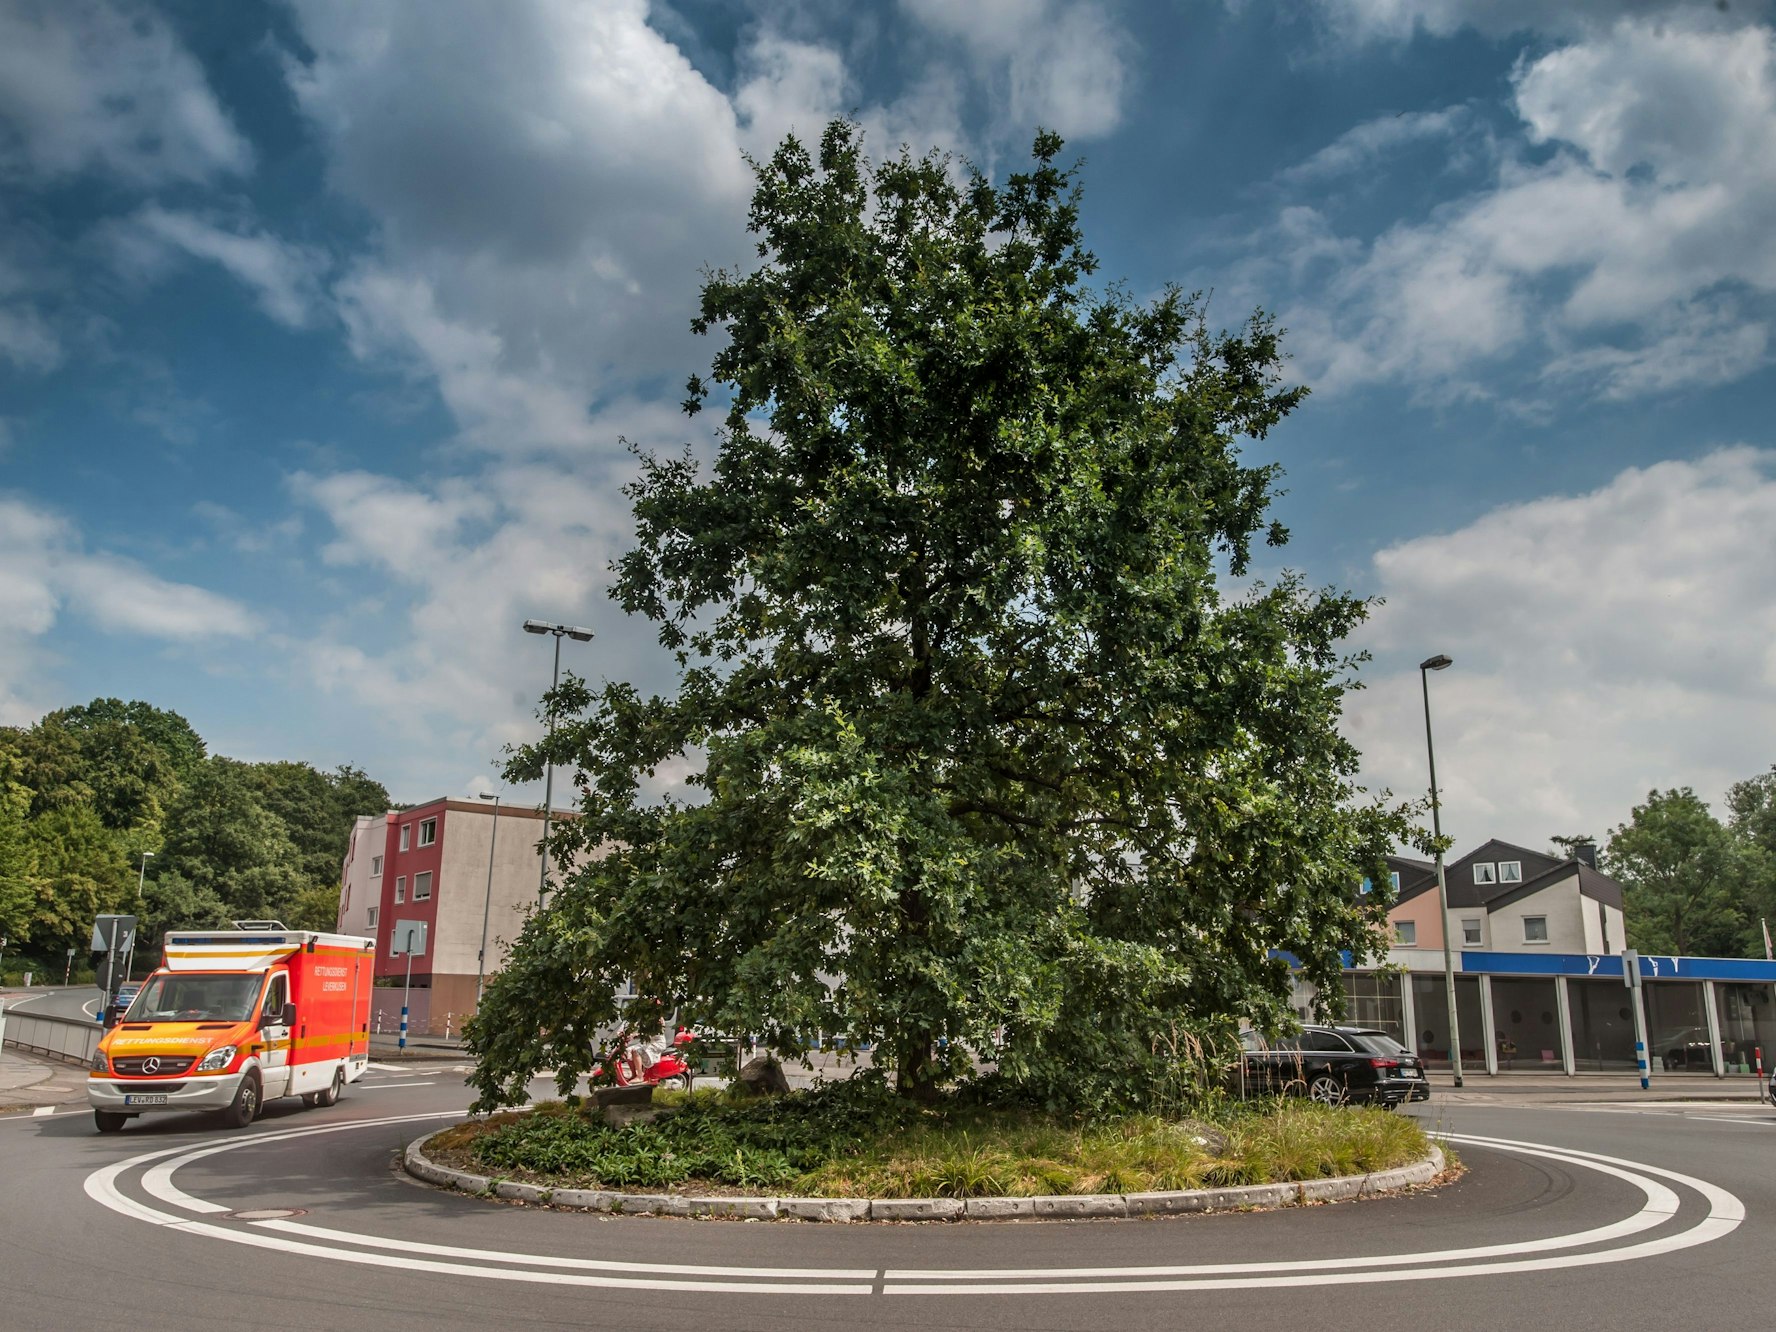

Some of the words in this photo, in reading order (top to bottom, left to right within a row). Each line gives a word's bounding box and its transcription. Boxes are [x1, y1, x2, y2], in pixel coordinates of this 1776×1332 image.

[314, 966, 347, 976] RETTUNGSDIENST
[323, 982, 346, 991] LEVERKUSEN
[112, 1037, 214, 1045] RETTUNGSDIENST
